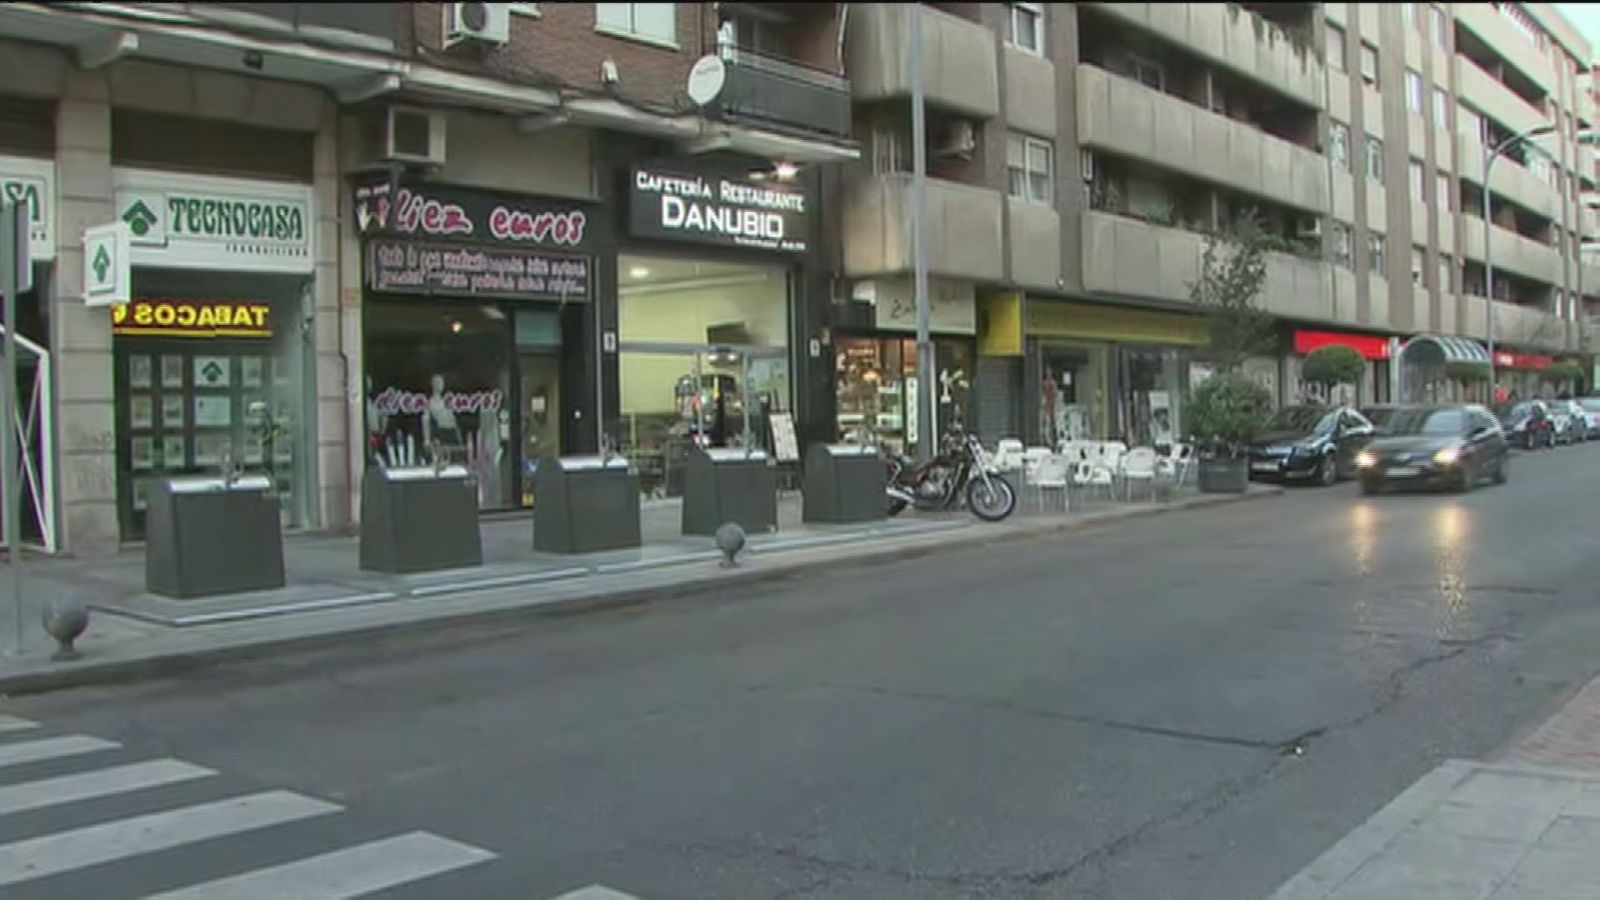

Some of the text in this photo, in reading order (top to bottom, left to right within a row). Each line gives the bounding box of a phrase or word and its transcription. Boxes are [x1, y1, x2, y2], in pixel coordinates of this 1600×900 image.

[661, 194, 784, 239] DANUBIO
[720, 180, 805, 212] RESTAURANTE
[169, 196, 303, 241] TECNOCASA
[489, 206, 585, 244] euros
